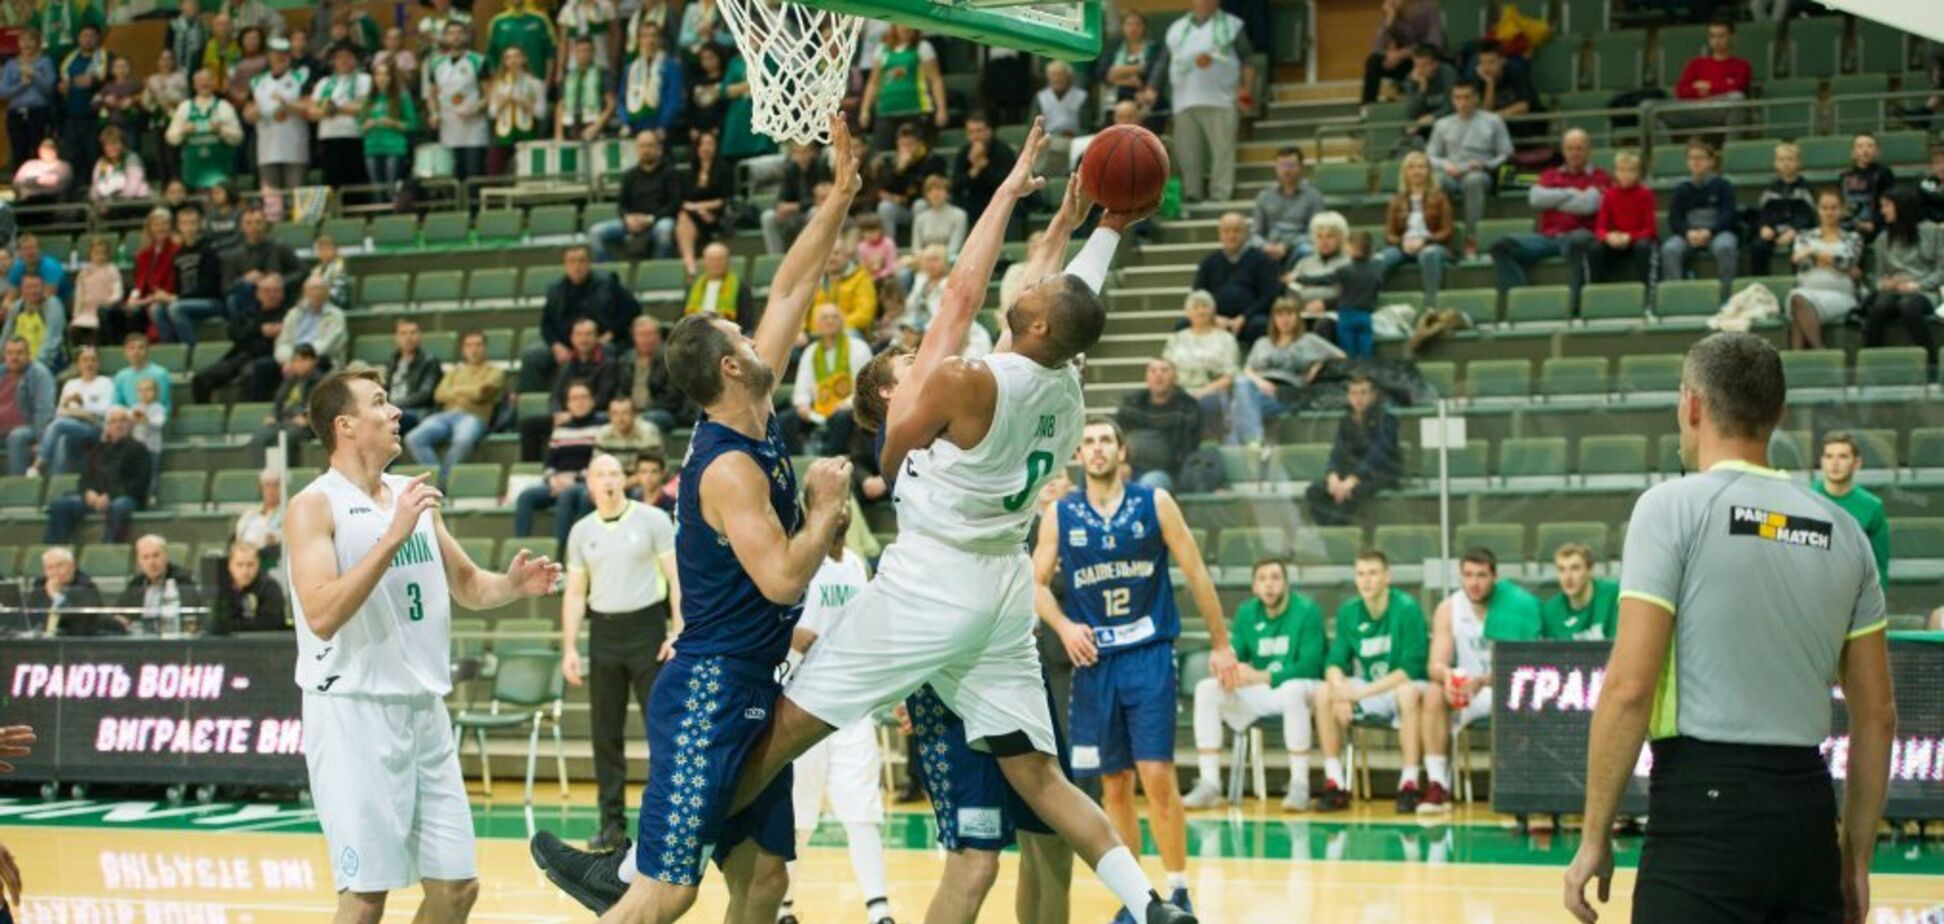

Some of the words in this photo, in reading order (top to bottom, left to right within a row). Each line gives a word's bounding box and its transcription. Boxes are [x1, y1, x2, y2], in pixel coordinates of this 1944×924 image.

[1734, 507, 1767, 524] PARI
[1777, 528, 1829, 549] MATCH
[407, 582, 424, 622] 3
[1102, 587, 1131, 617] 12
[11, 664, 131, 698] ГРАЮТЬ
[137, 664, 224, 699] ВОНИ
[95, 717, 252, 753] ВИГРАЄТЕ
